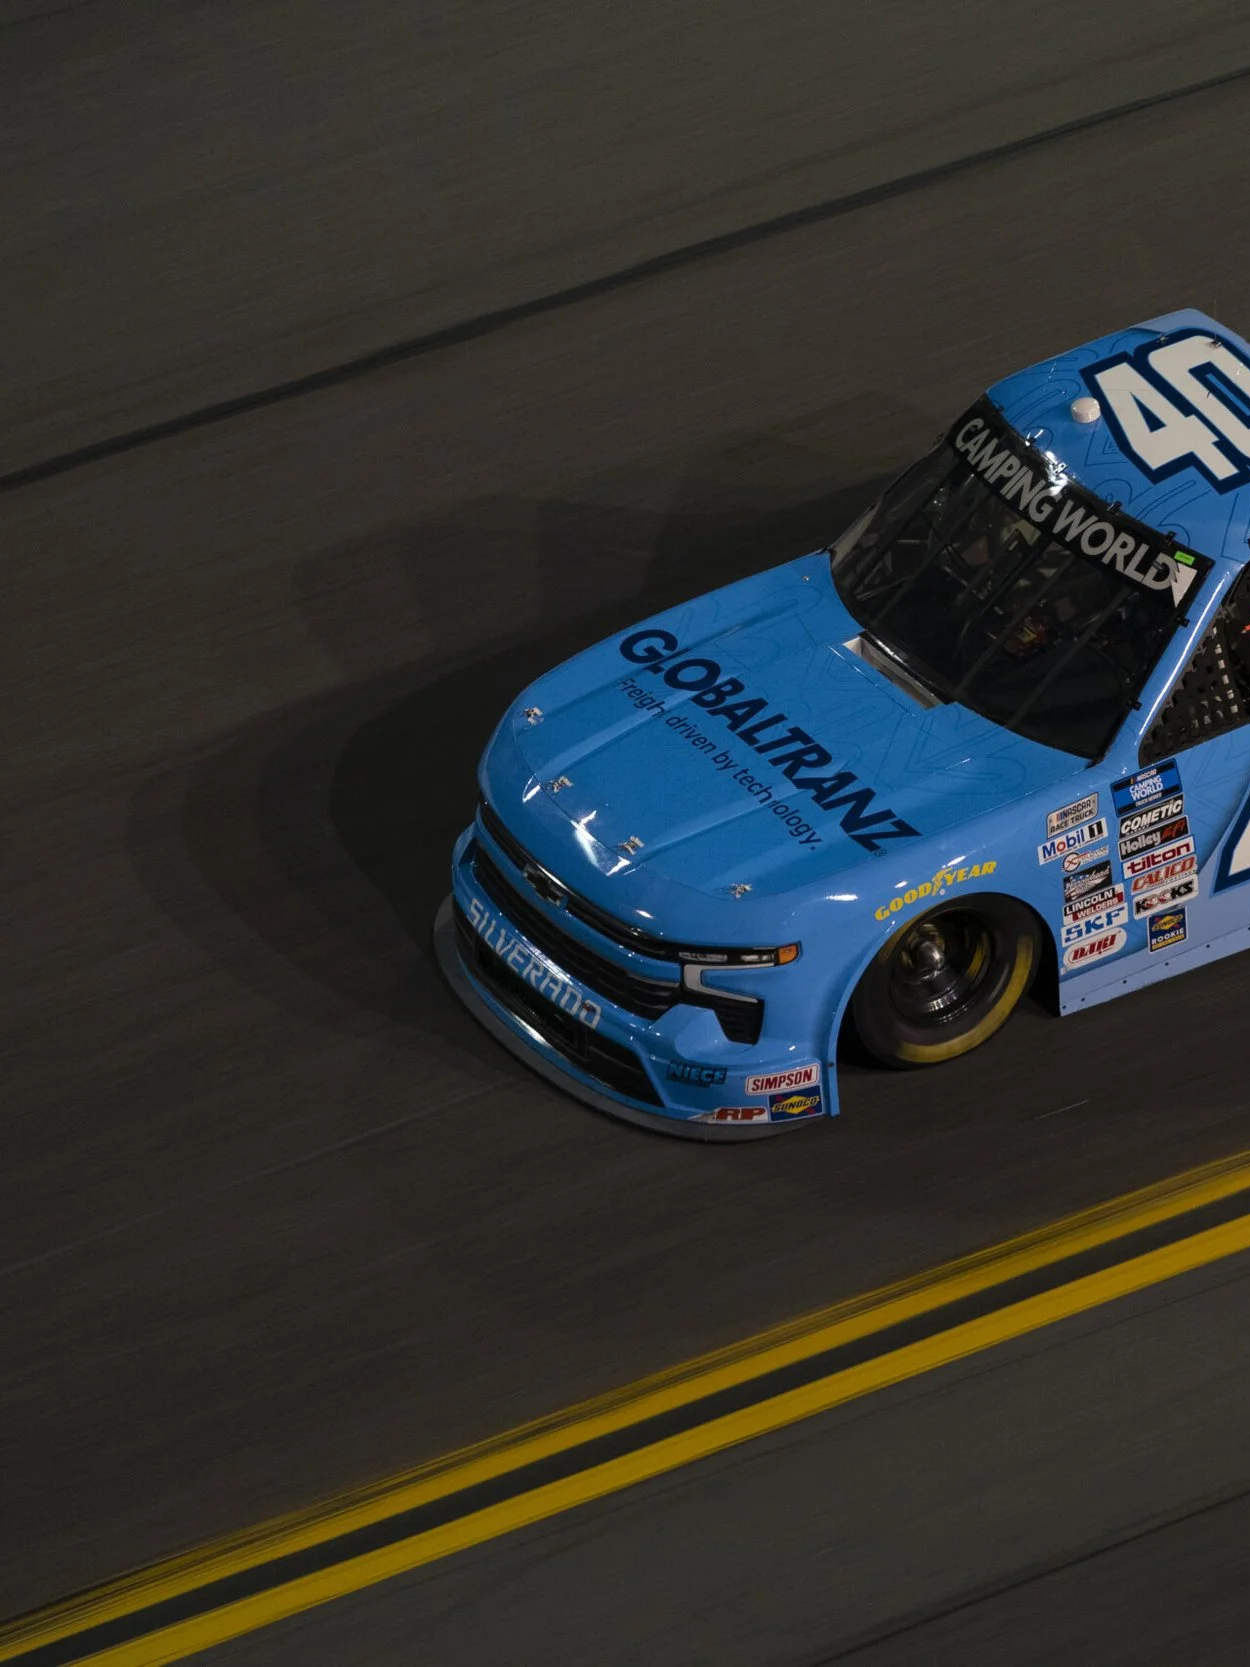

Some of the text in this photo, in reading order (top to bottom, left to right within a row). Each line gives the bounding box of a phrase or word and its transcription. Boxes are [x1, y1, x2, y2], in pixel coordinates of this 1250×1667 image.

[955, 417, 1178, 591] CAMPING WORLD
[619, 629, 923, 852] GLOBALTRANZ
[665, 711, 717, 755] driven
[711, 749, 738, 772] by
[1129, 775, 1162, 793] CAMPING
[1131, 783, 1163, 800] WORLD
[1050, 808, 1094, 834] RACE TRUCK
[1060, 799, 1092, 819] NASCAR
[1121, 800, 1182, 834] COMETIC
[1042, 828, 1085, 858] Mobil
[1120, 829, 1161, 856] Holley
[1127, 842, 1191, 874] tilton
[1132, 856, 1195, 892] CALICO
[874, 859, 998, 922] GOODYEAR
[1066, 887, 1114, 915] LINCOLN
[1077, 896, 1119, 919] WELDERS
[1065, 907, 1125, 943] SKF
[1151, 928, 1185, 945] ROOKIE
[467, 898, 603, 1029] SILVERADO
[668, 1060, 727, 1084] NIECE
[751, 1068, 815, 1092] SIMPSON
[772, 1095, 820, 1112] SUNOCO
